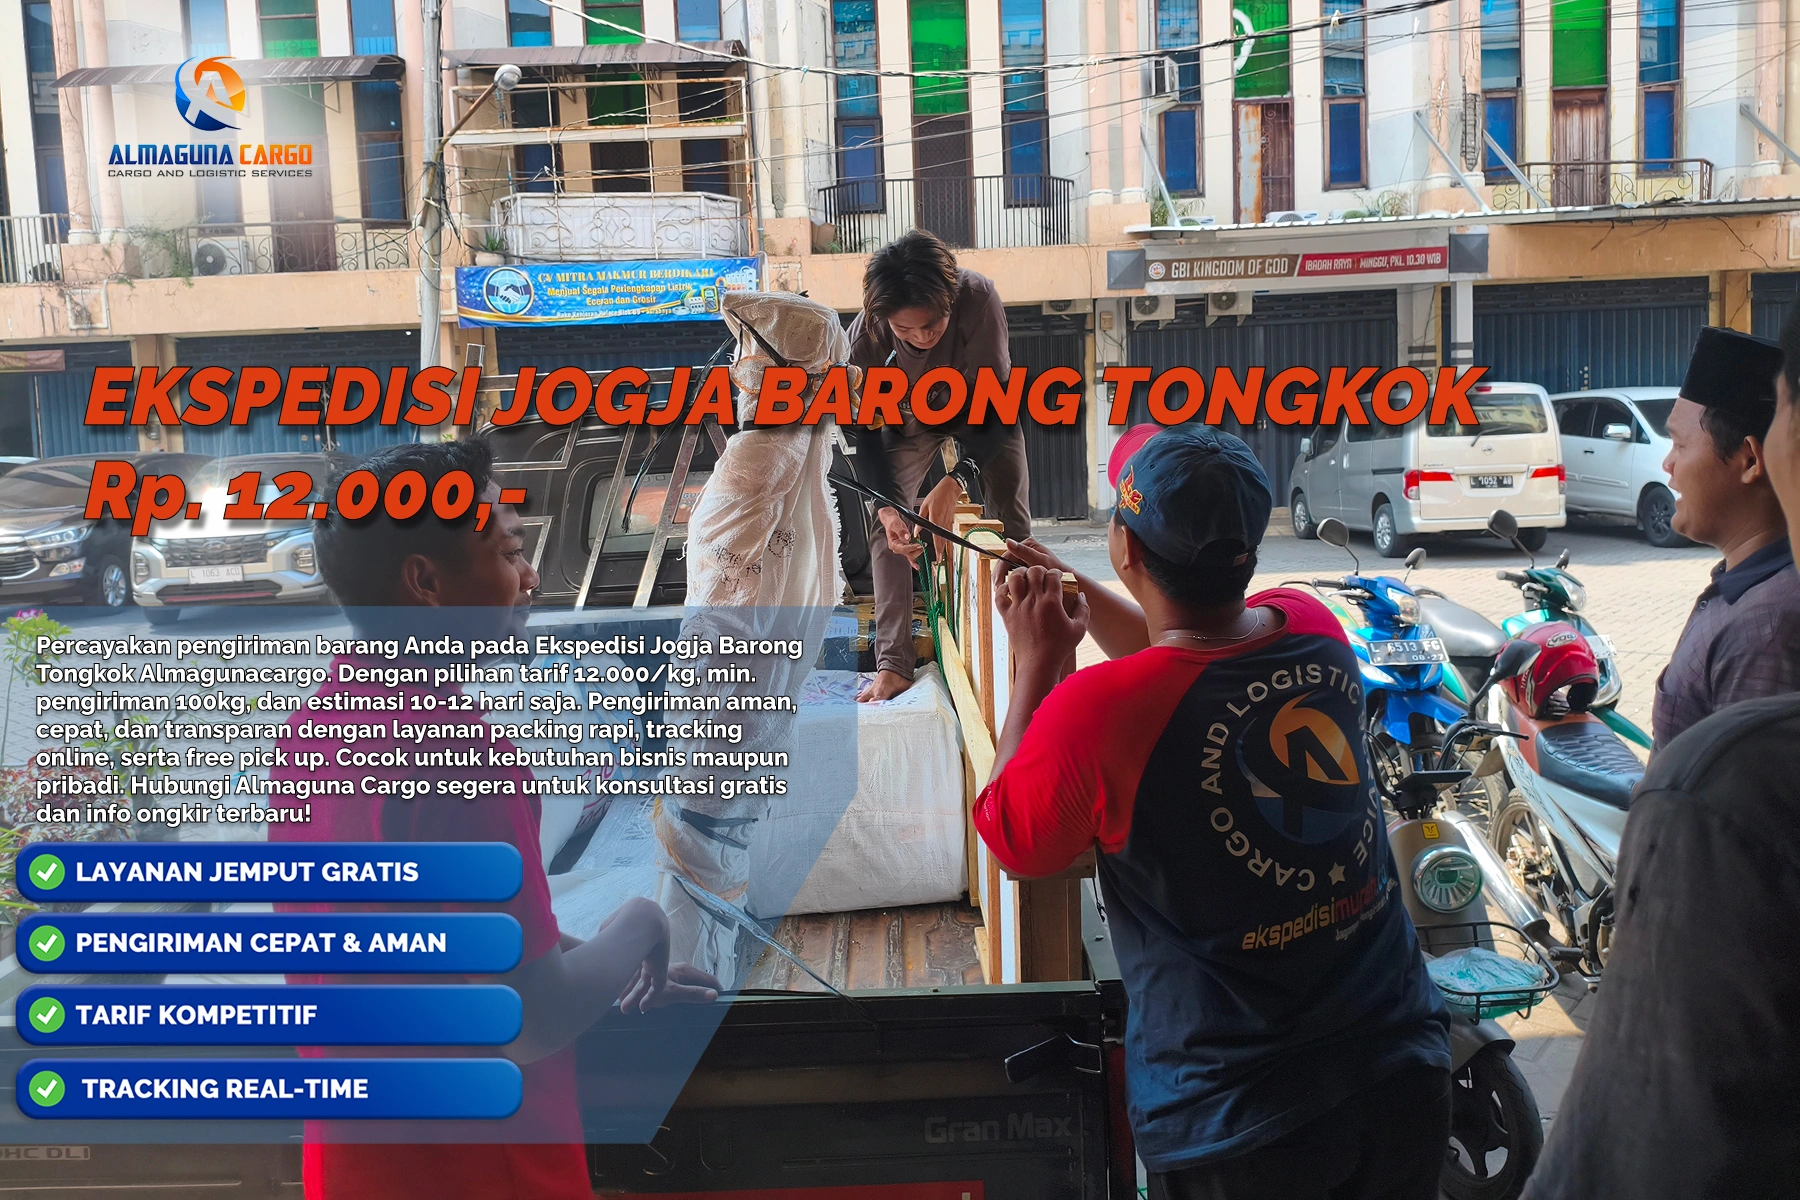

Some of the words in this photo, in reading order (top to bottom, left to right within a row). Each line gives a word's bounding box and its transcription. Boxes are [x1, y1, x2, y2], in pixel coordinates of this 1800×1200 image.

[1171, 262, 1191, 278] GBI
[1193, 260, 1245, 277] KINGDOM
[1247, 259, 1262, 275] OF
[1265, 258, 1289, 275] GOD
[1359, 255, 1389, 269] MINGGU,
[1406, 253, 1426, 266] 10.30
[1426, 252, 1441, 265] WIB
[556, 271, 594, 283] MITRA
[596, 270, 647, 281] MAKMUR
[650, 267, 715, 280] BERDIKARI
[547, 286, 580, 297] Menjual
[582, 285, 609, 296] Segala
[611, 284, 666, 295] Perlengkapan
[668, 282, 693, 292] Listrik
[586, 297, 613, 306] Eceran
[615, 296, 630, 305] dan
[632, 295, 657, 304] Grosir
[1470, 476, 1476, 486] L
[191, 568, 195, 578] L
[1369, 643, 1380, 653] L
[1387, 642, 1418, 653] 6513
[1226, 663, 1360, 717] LOGISTIC
[1201, 722, 1229, 795] AND
[1210, 807, 1316, 892] CARGO
[925, 1116, 999, 1143] Gran
[1007, 1112, 1073, 1139] Max
[0, 1147, 39, 1159] HC
[46, 1147, 89, 1159] DLI
